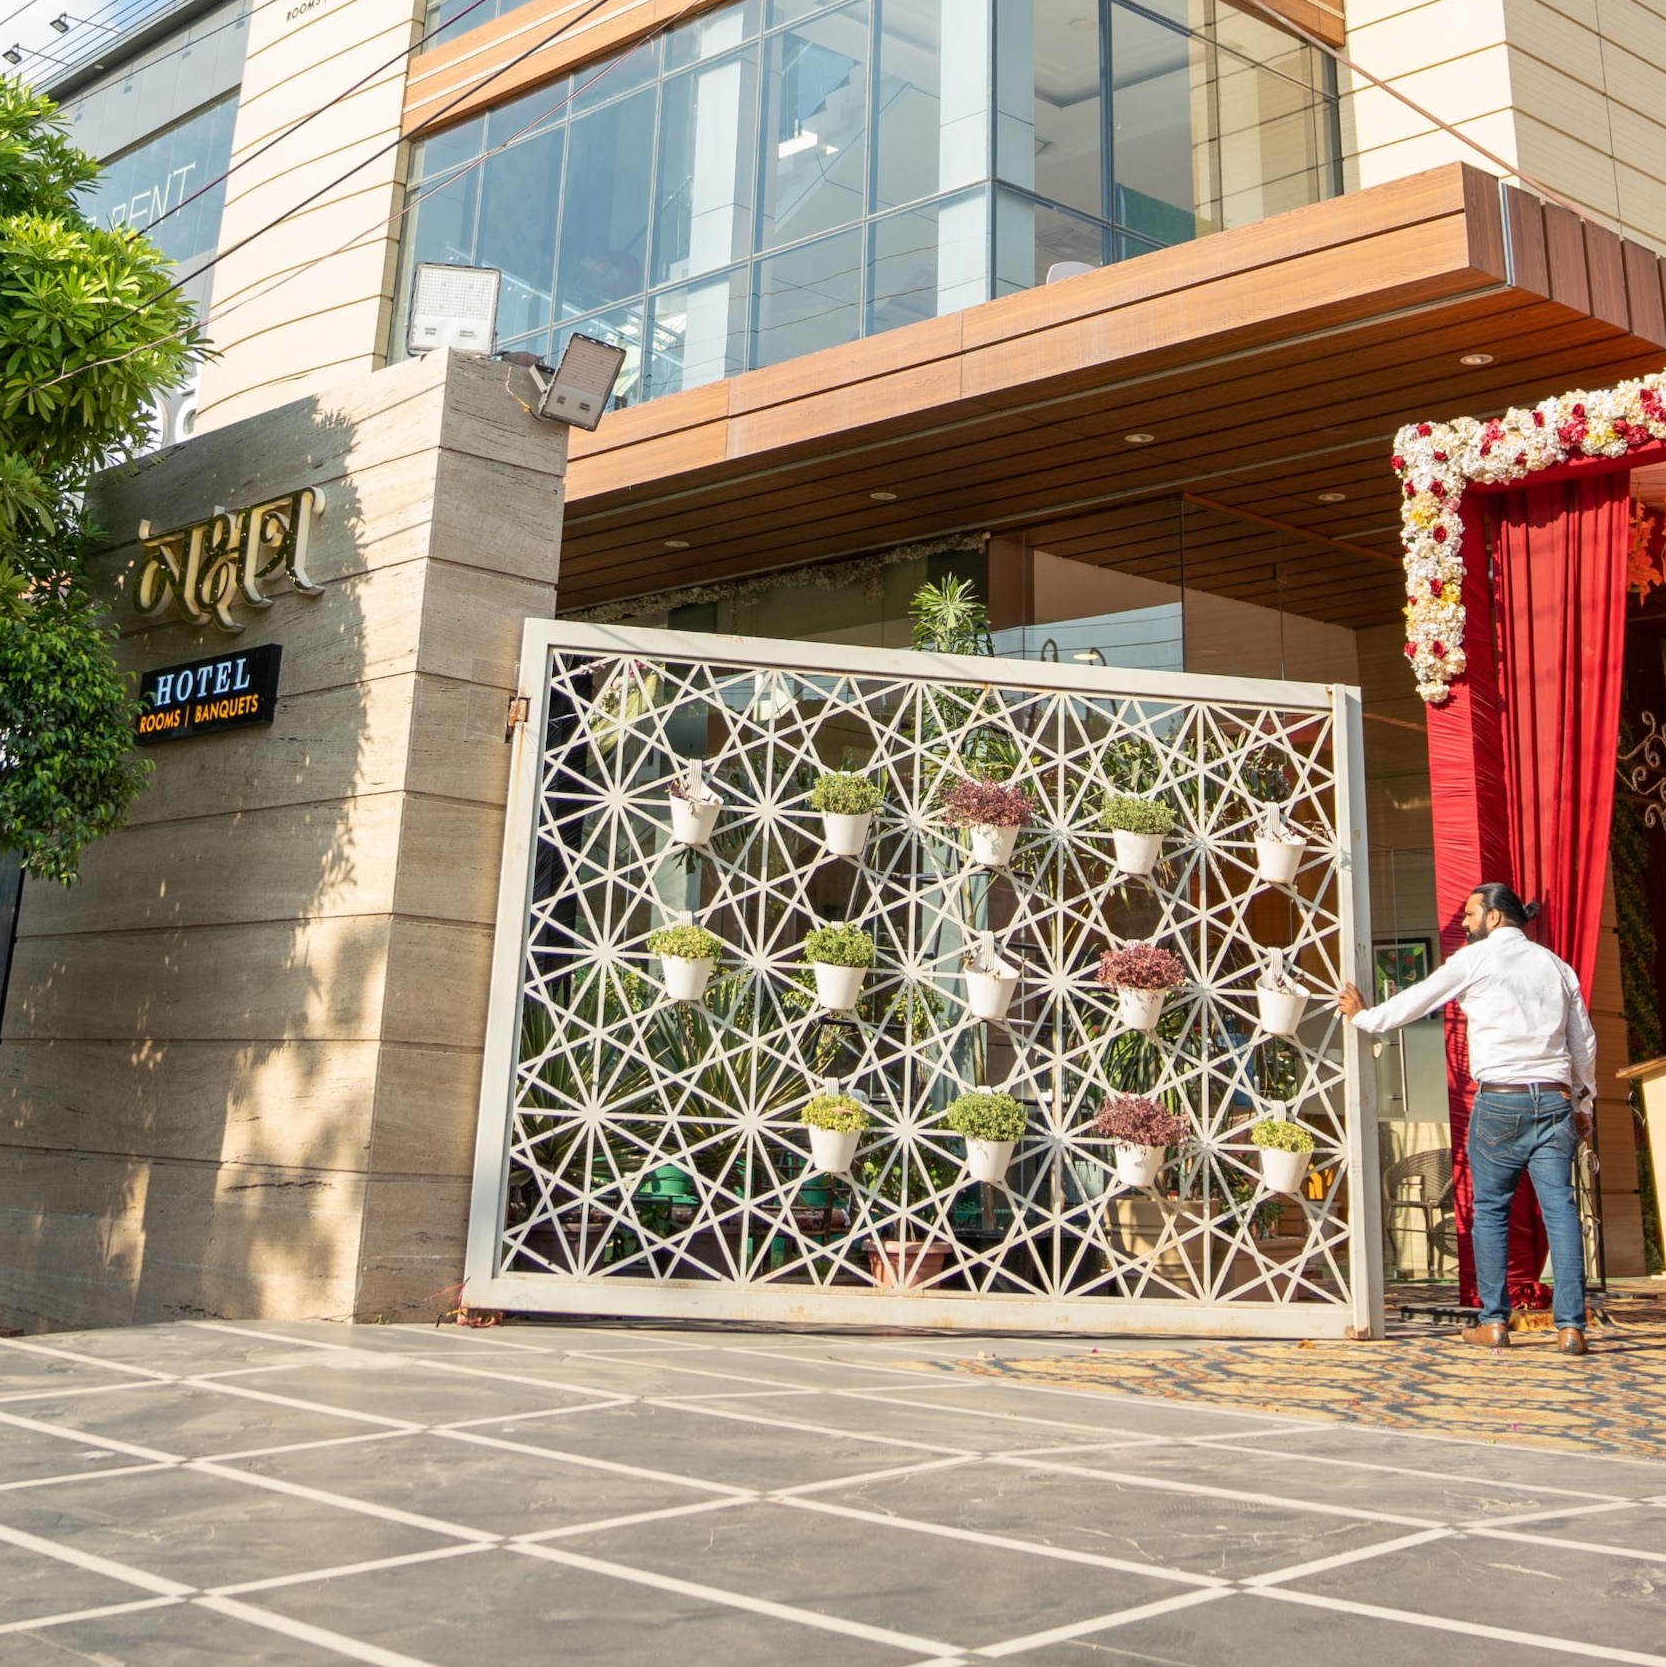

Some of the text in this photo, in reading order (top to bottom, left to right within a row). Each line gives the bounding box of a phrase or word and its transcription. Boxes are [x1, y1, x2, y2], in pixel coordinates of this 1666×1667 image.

[154, 657, 251, 707] HOTEL
[139, 693, 259, 734] ROOMS BANQUETS
